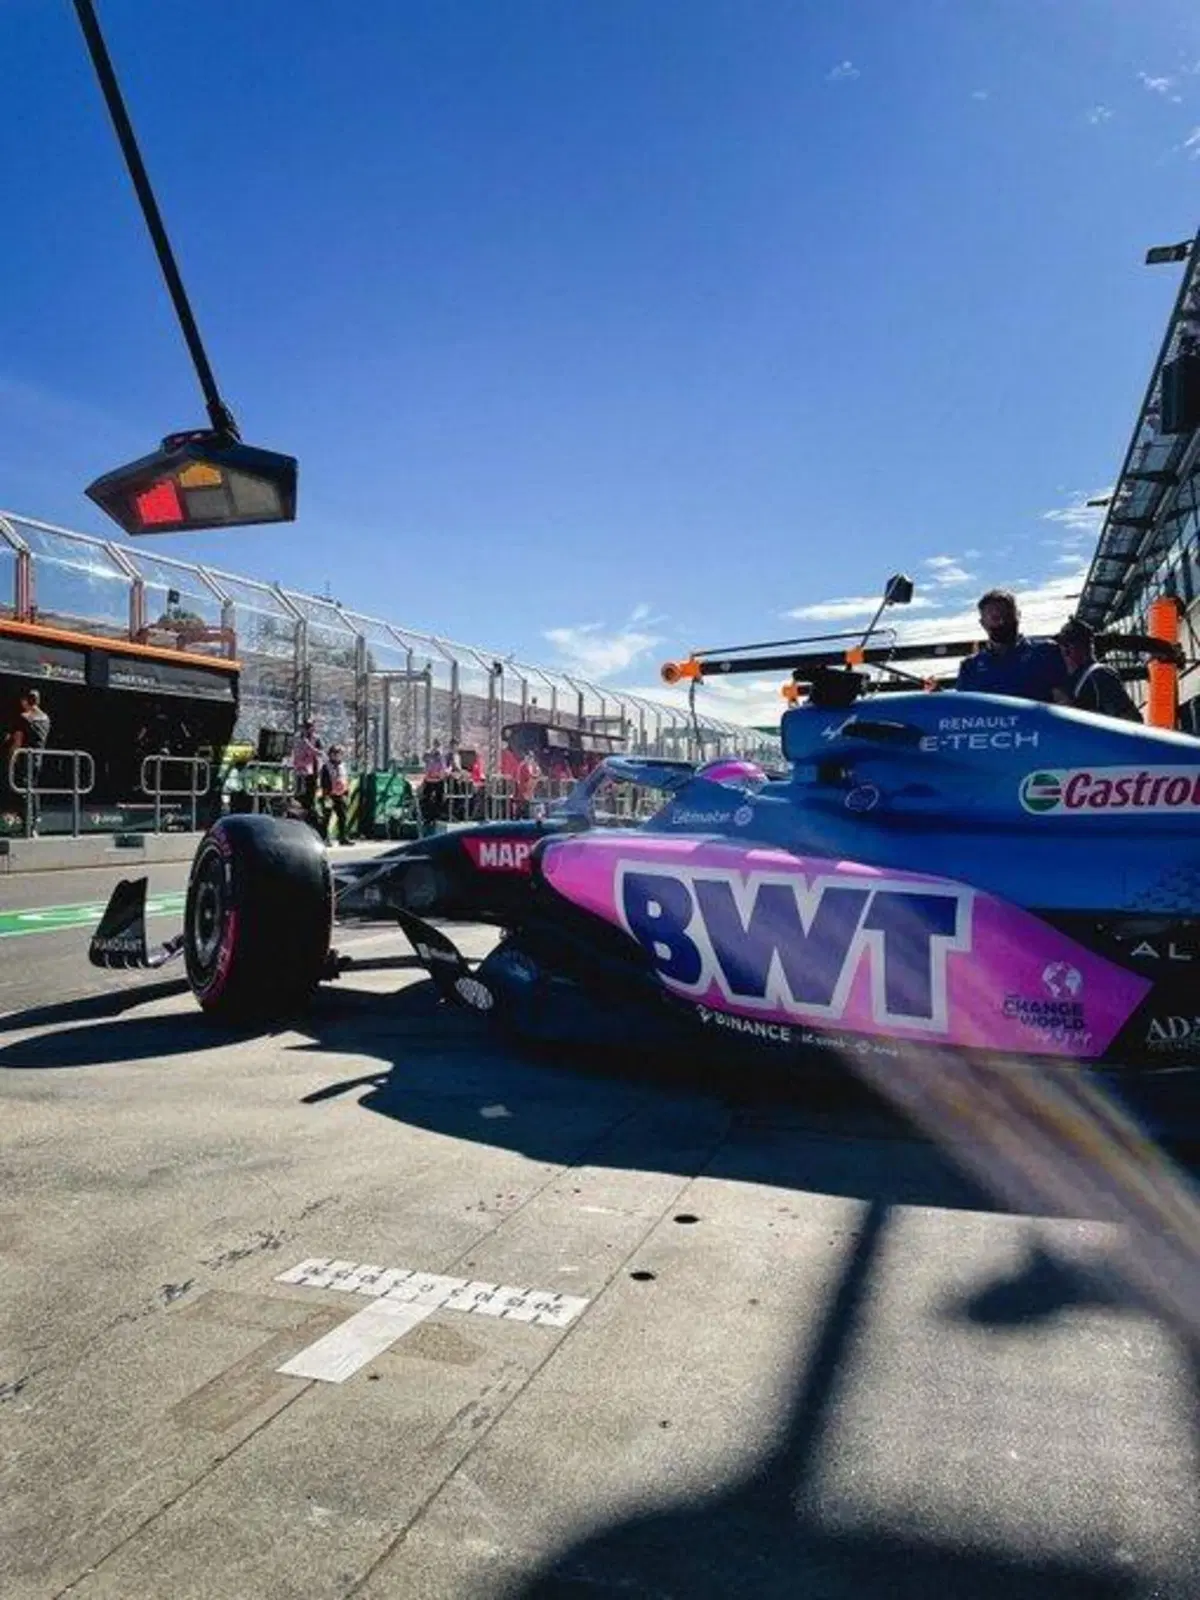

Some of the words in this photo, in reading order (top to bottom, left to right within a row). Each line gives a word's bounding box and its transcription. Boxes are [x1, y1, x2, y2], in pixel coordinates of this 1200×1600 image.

[938, 715, 1020, 731] RENAULT
[919, 731, 1040, 751] E-TECH
[619, 866, 965, 1026] BWT
[715, 1010, 793, 1041] BINANCE
